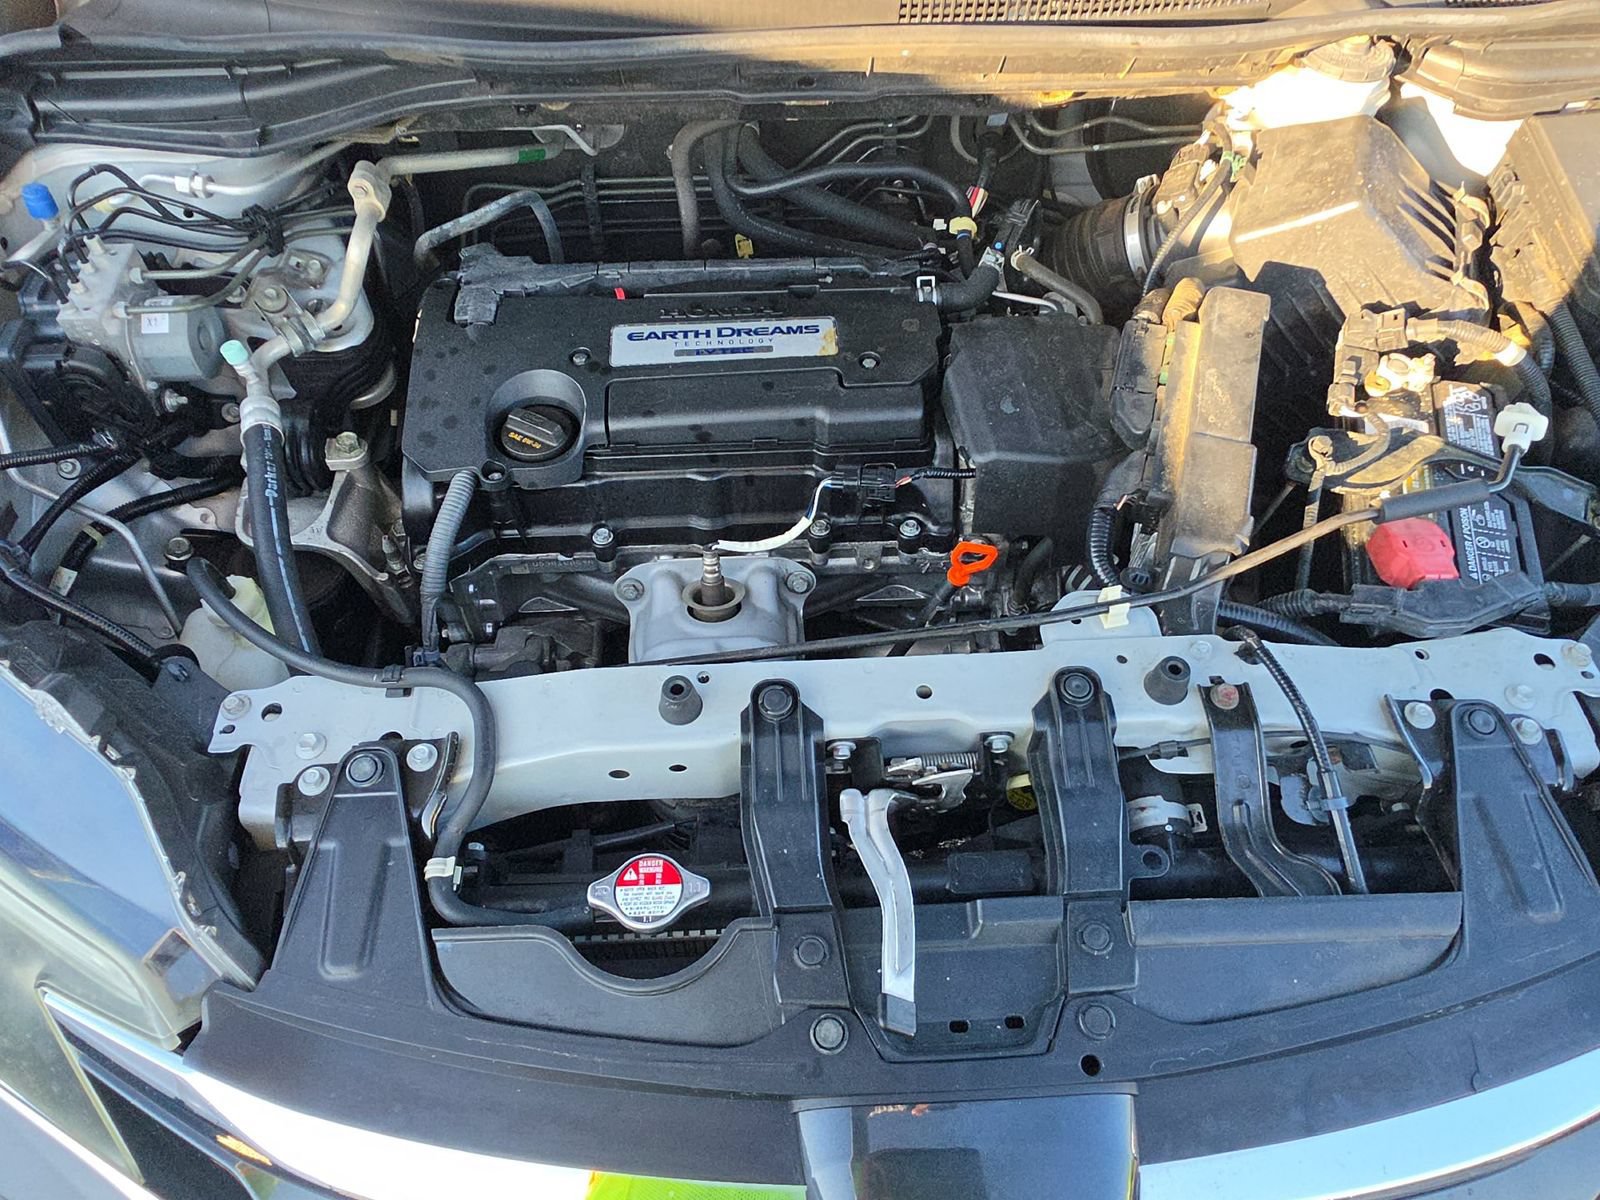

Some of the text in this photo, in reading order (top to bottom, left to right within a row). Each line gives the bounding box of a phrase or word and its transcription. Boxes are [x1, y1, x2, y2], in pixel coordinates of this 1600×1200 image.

[660, 303, 784, 319] HONDA
[627, 325, 820, 342] EARTH DREAMS
[674, 338, 775, 347] TECHNOLOGY
[264, 462, 277, 497] Parker
[1459, 507, 1471, 535] POISON
[1464, 541, 1477, 572] DANGER
